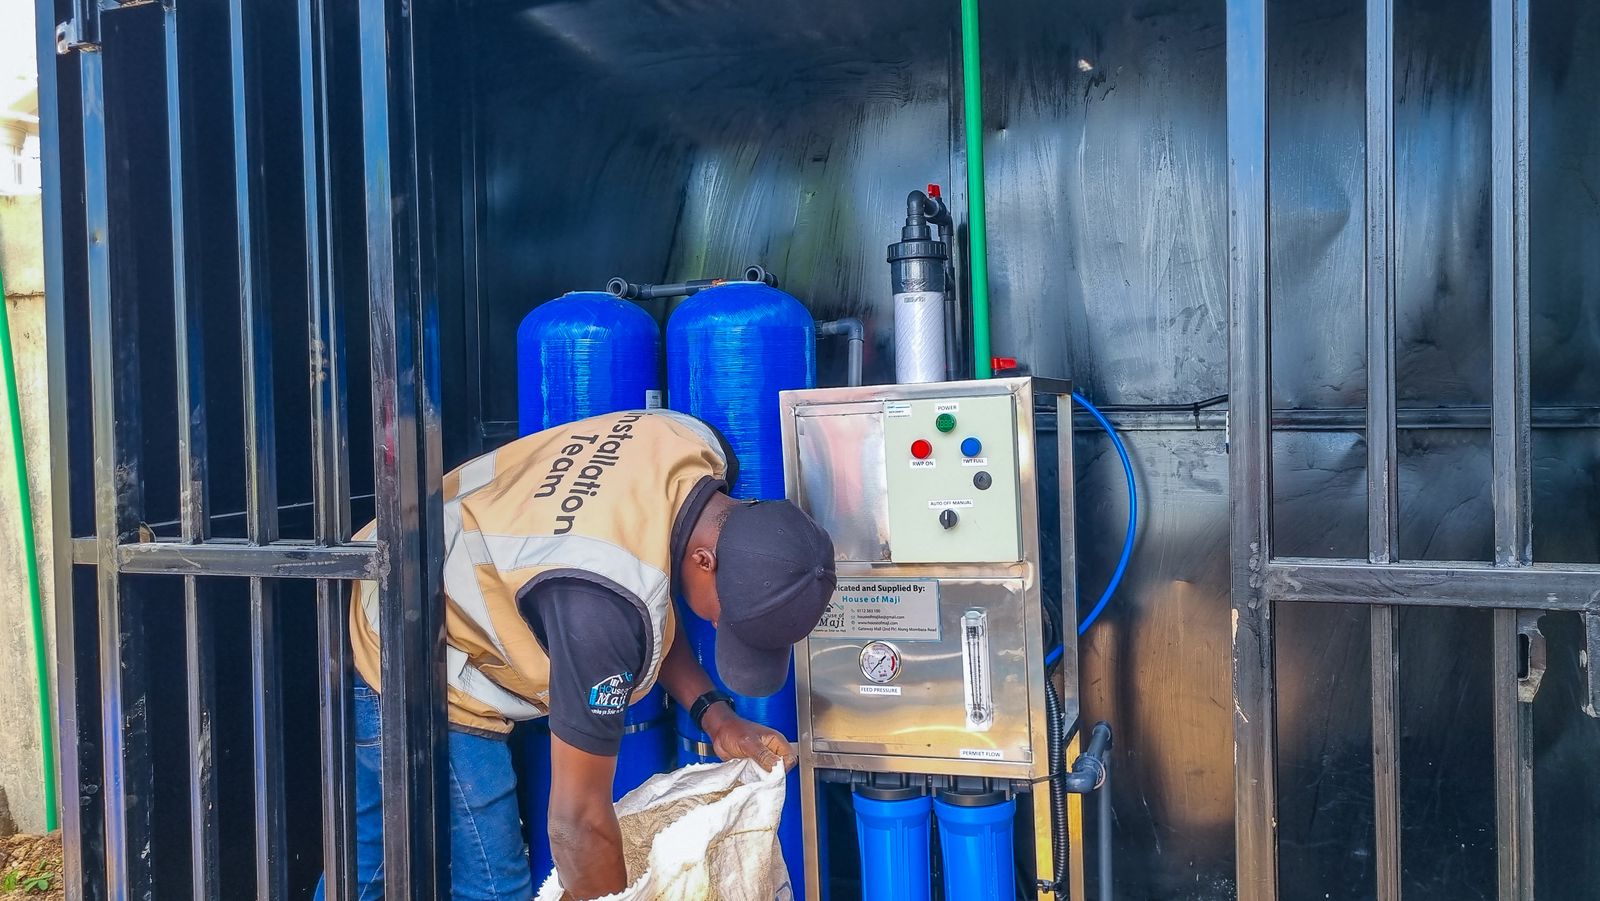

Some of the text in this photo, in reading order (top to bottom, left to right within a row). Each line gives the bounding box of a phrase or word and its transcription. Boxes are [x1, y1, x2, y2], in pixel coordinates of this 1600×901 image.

[534, 434, 599, 498] Team
[835, 584, 926, 593] ricated and Supplied By:
[842, 595, 901, 604] House of Maji
[818, 617, 845, 629] Maji
